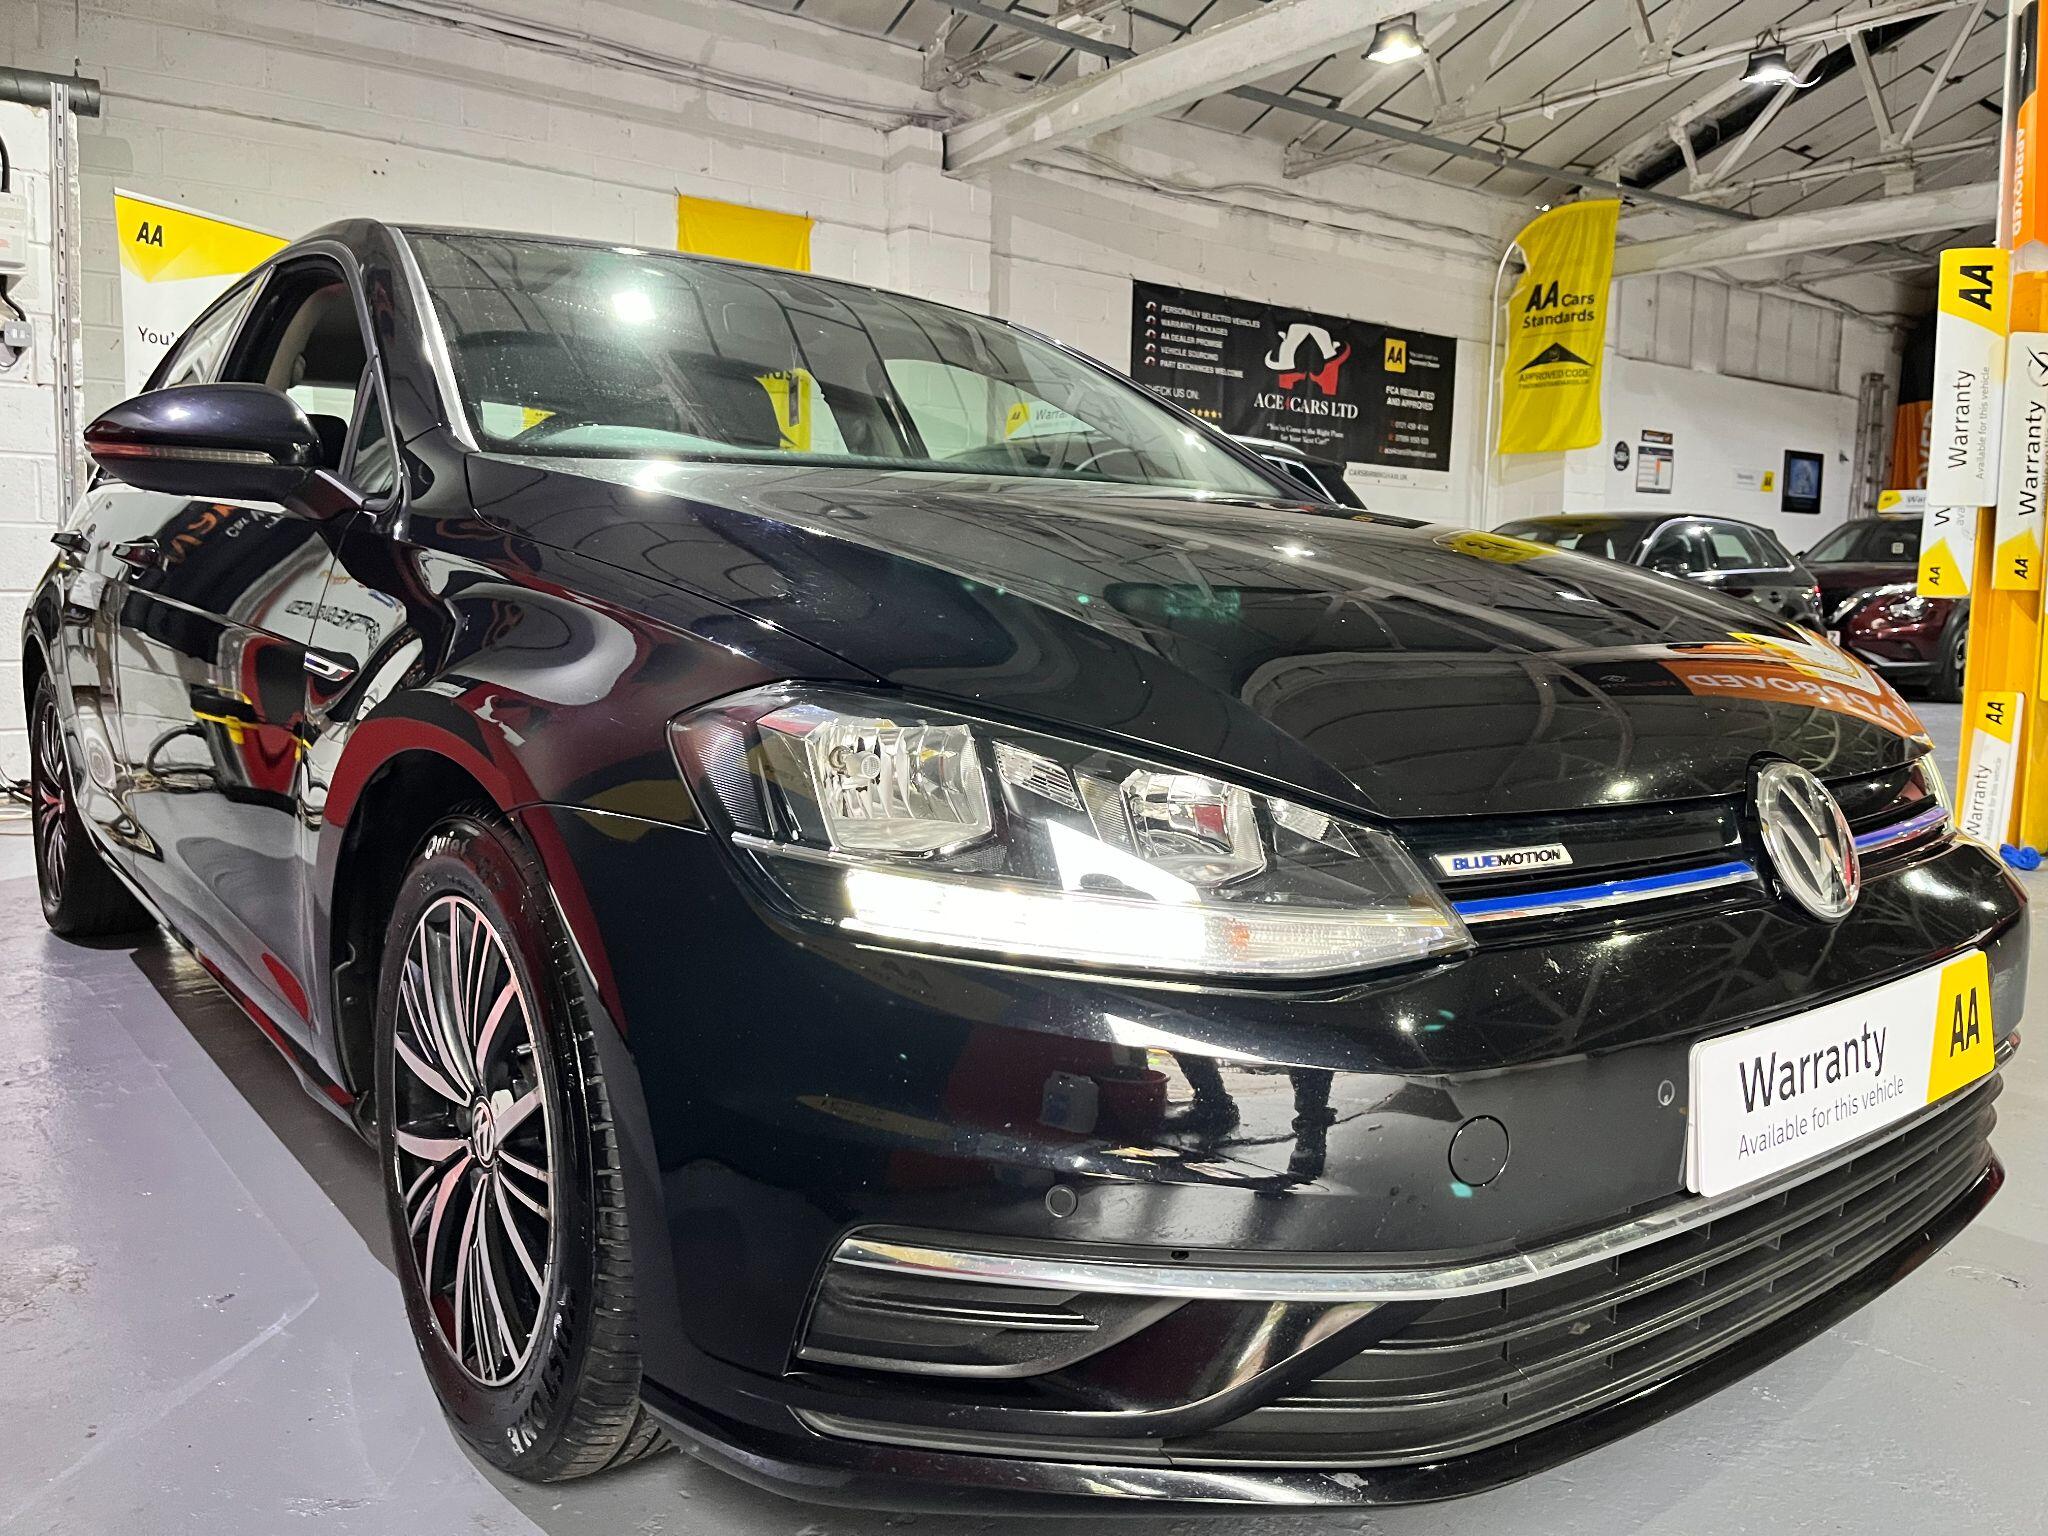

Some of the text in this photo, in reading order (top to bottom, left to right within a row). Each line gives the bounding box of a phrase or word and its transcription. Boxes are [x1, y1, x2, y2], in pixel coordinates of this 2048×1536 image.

[136, 222, 163, 247] AA
[1525, 280, 1594, 312] AA Cars
[1959, 265, 1994, 311] AA
[1523, 309, 1594, 328] Standards
[1387, 346, 1402, 364] AA
[1173, 388, 1184, 398] US
[1332, 402, 1358, 418] LTD
[1948, 370, 1976, 468] Warranty
[1976, 366, 1990, 479] Available for this vehicle
[2018, 401, 2046, 516] Warranty
[1929, 567, 1941, 586] AA
[2014, 559, 2028, 579] AA
[1986, 702, 2005, 725] AA
[1966, 764, 1992, 836] Warranty
[1452, 849, 1560, 870] BLUEMOTION
[1950, 987, 1980, 1058] AA
[1739, 1020, 1887, 1114] Warranty
[1738, 1075, 1904, 1160] Available for this vehicle
